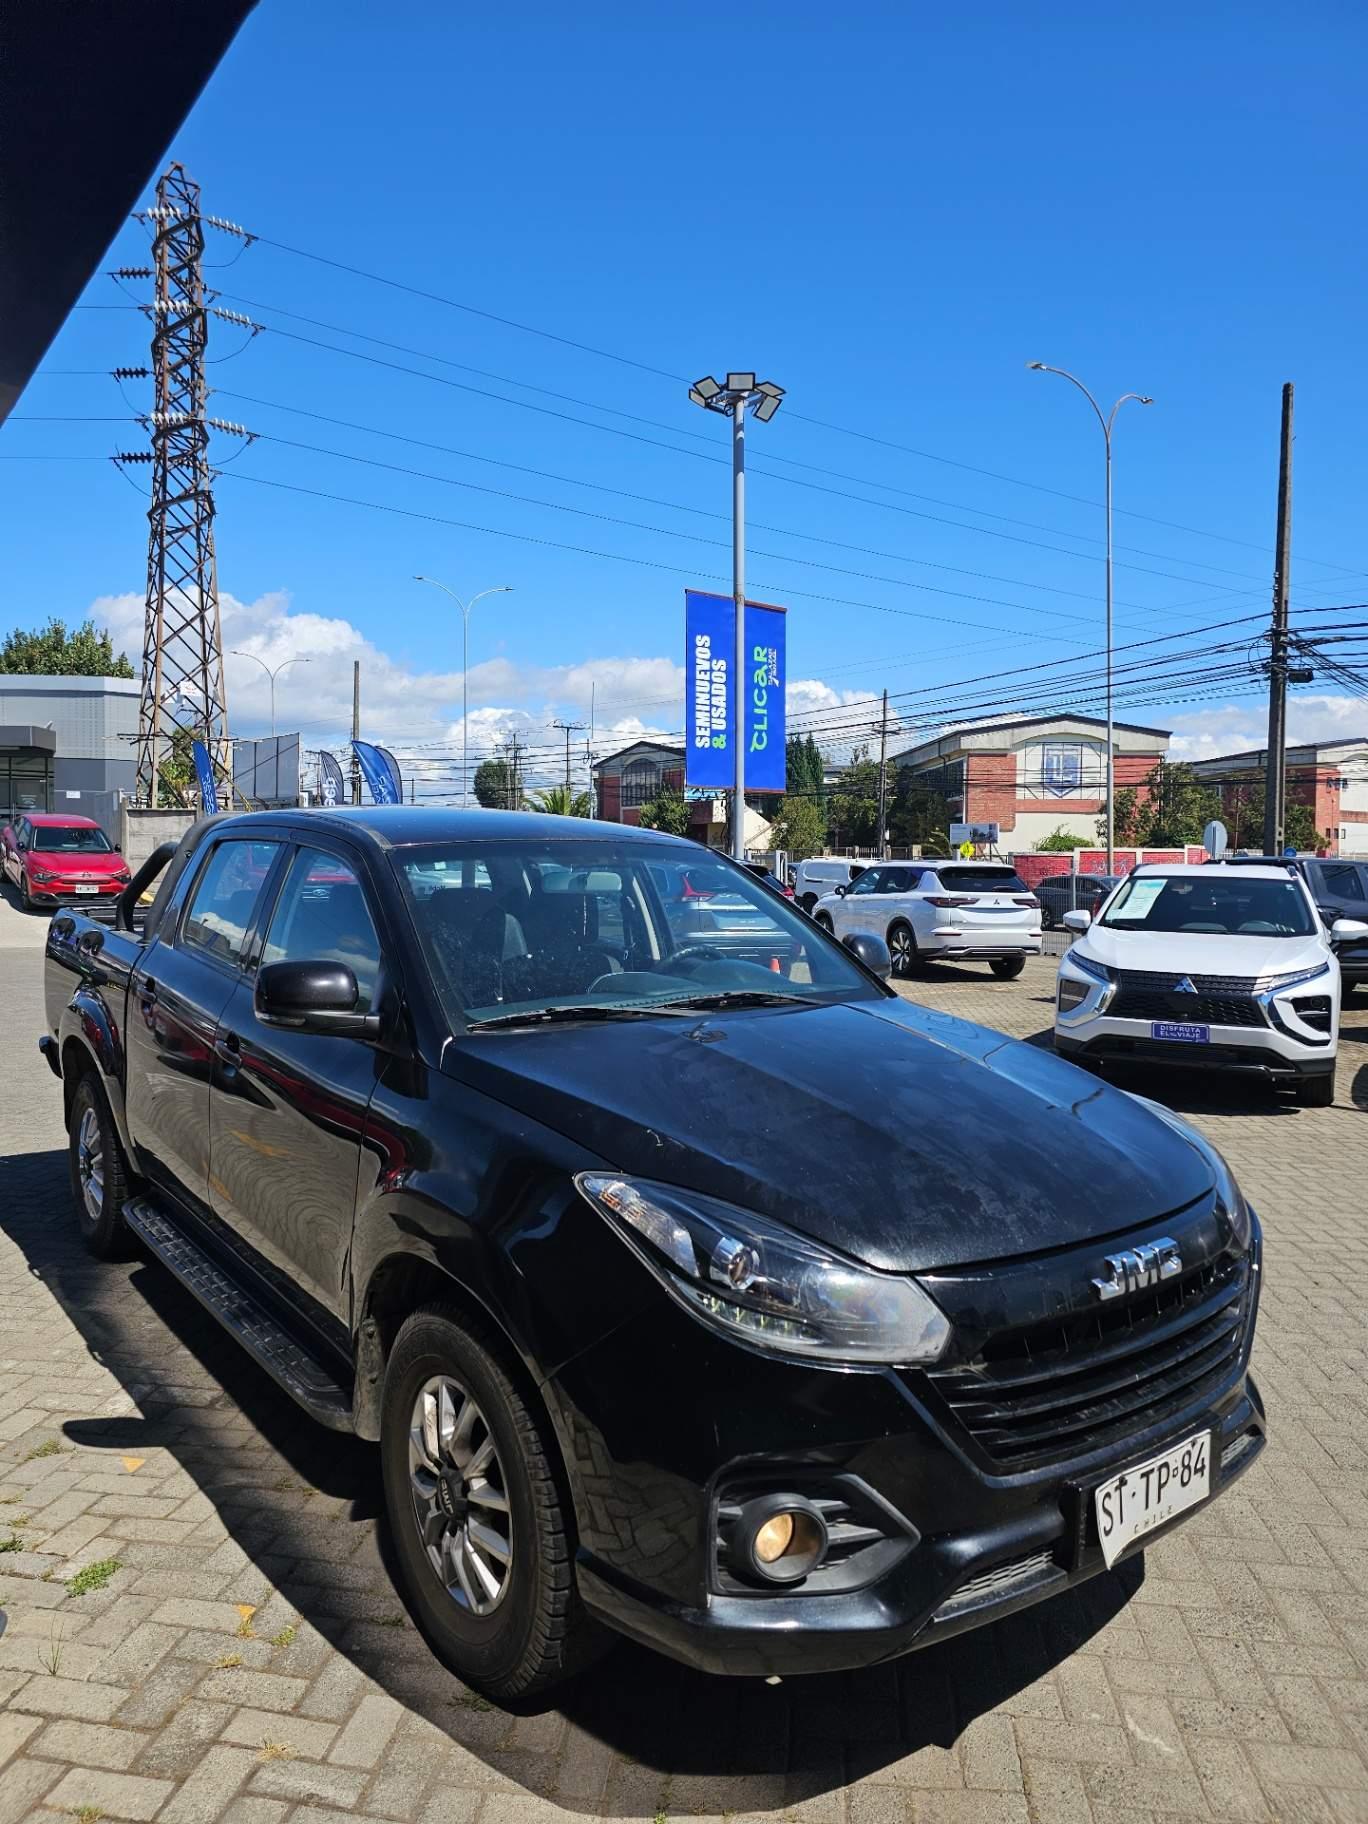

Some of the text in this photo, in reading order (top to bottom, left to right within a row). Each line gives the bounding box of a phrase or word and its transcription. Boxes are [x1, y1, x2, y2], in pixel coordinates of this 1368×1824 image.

[696, 635, 711, 748] SEMINUEVOS
[712, 659, 726, 749] & USADOS
[1160, 1025, 1201, 1034] DISFRUTA
[1091, 1237, 1182, 1300] JMC
